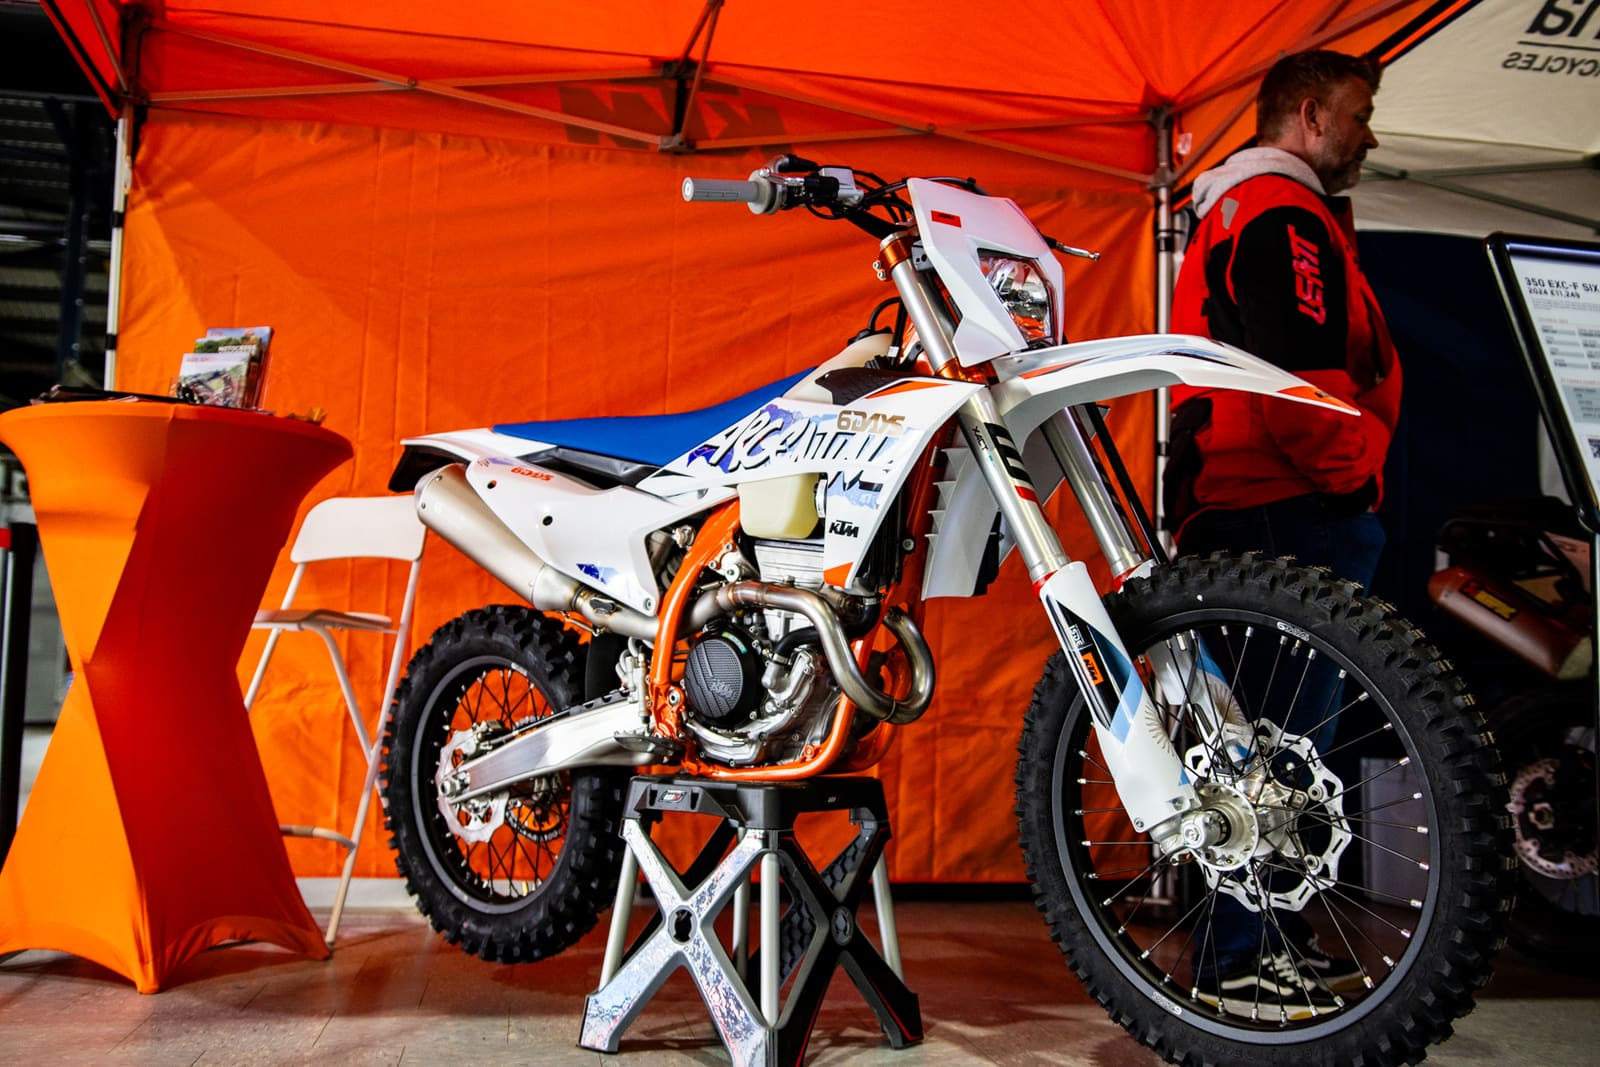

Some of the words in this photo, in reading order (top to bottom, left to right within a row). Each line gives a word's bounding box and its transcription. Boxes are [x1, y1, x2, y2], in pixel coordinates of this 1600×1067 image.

[1525, 277, 1545, 288] 350
[1548, 279, 1579, 291] EXC-F
[972, 426, 989, 451] XACT
[829, 520, 859, 538] KTM
[1083, 656, 1099, 681] KTM
